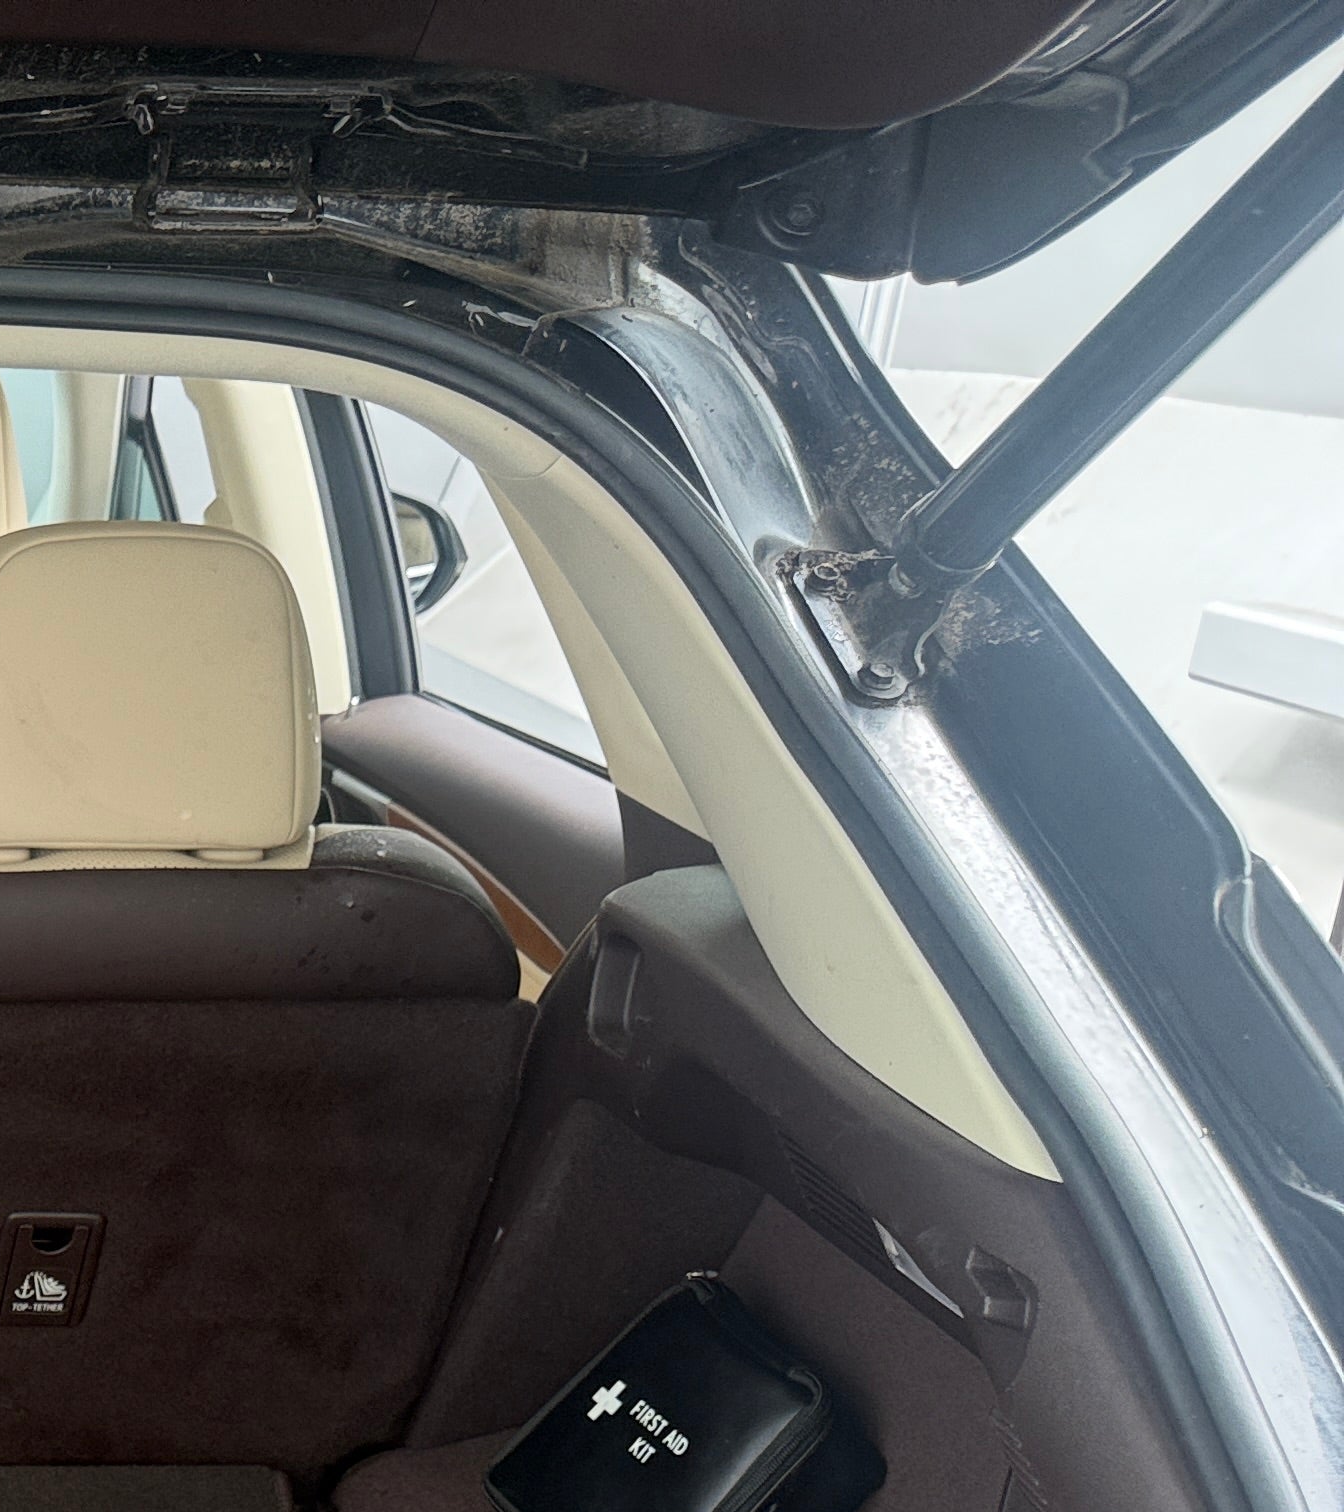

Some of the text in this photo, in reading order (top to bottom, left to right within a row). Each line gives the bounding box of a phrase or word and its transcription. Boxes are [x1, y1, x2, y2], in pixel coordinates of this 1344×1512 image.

[629, 1399, 689, 1456] FIRST AID
[628, 1436, 656, 1464] KIT
